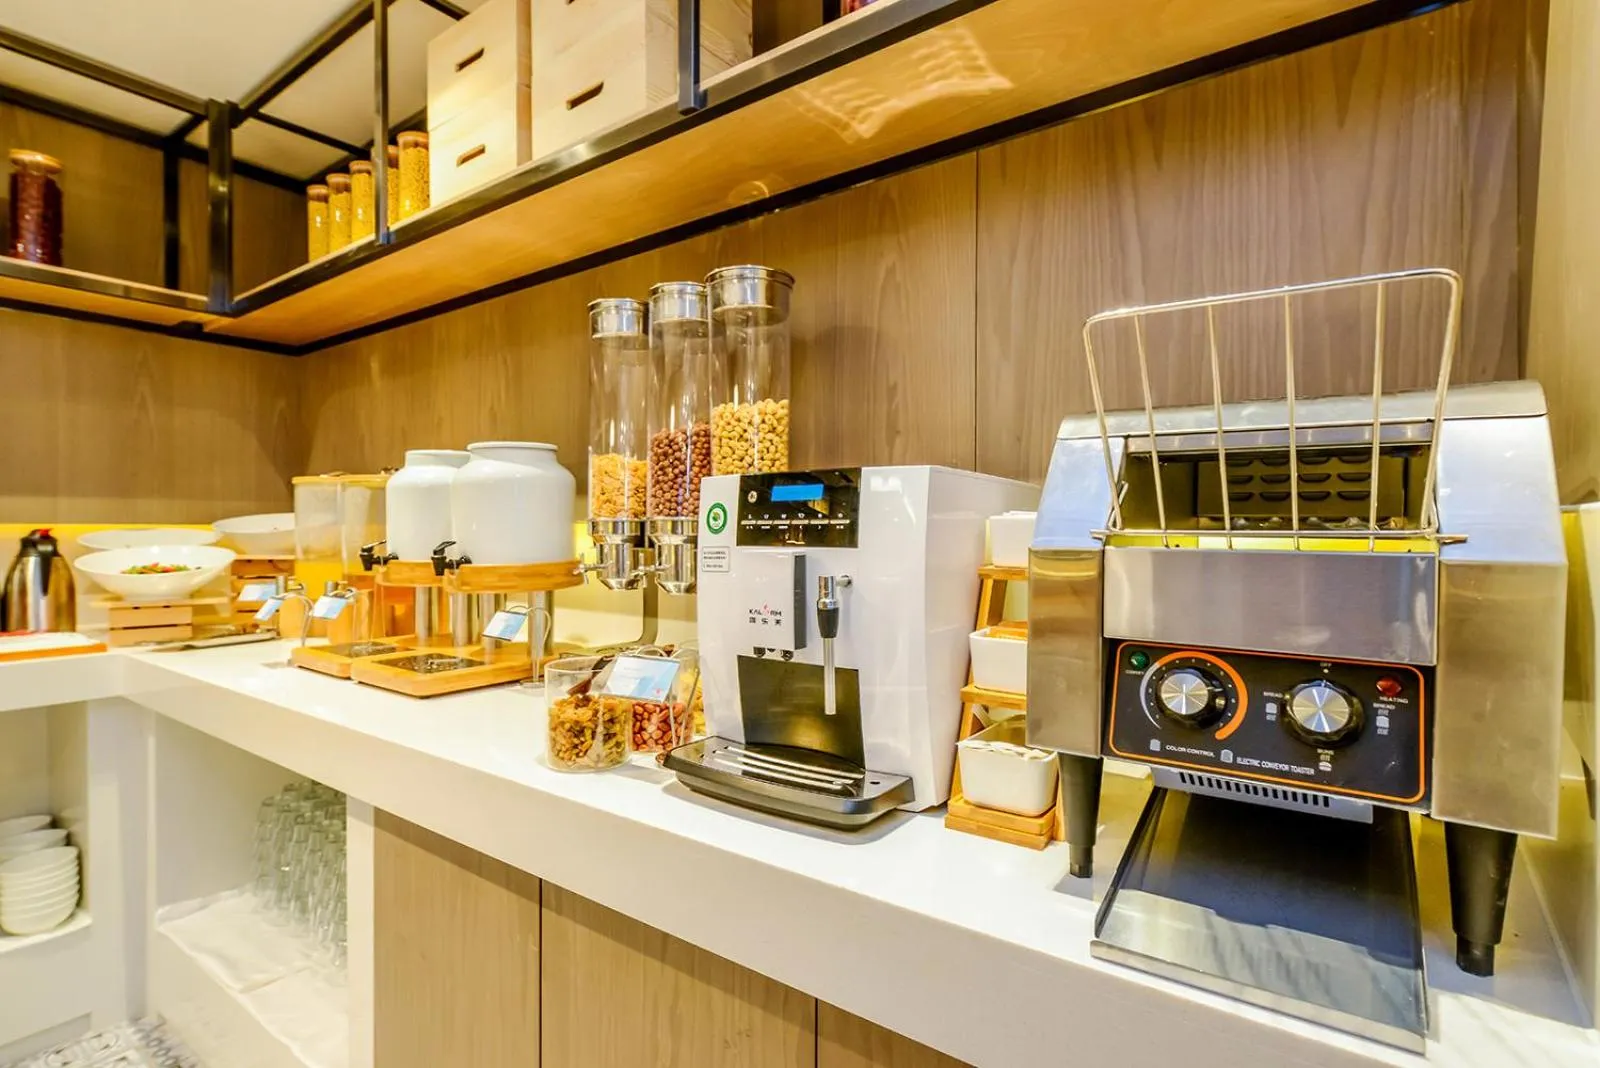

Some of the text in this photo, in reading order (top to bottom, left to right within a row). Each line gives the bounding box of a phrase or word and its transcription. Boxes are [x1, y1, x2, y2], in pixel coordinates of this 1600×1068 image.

[1379, 696, 1408, 704] HEATING
[1165, 744, 1215, 757] COLOR CONTROL
[1236, 756, 1315, 776] ELECTRIC CONVEYOR TOASTER
